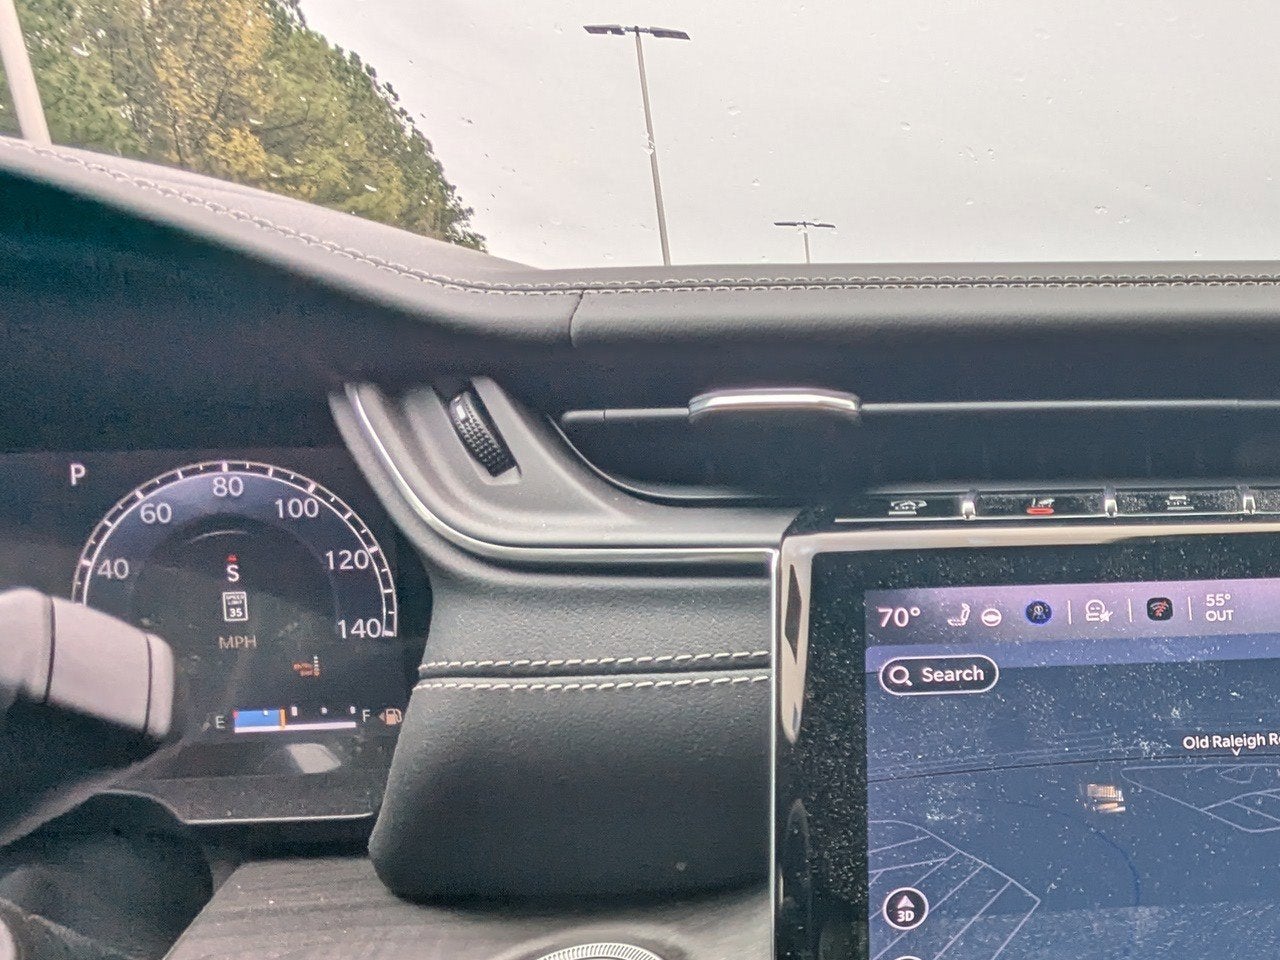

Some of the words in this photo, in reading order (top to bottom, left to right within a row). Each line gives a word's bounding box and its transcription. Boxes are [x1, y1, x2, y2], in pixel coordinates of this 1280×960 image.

[70, 463, 87, 486] P
[212, 477, 244, 497] 80
[140, 503, 172, 524] 60
[275, 498, 319, 520] 100
[97, 559, 130, 580] 40
[325, 549, 370, 571] 120
[227, 565, 240, 583] S
[1205, 593, 1231, 607] 55°
[230, 607, 243, 618] 35
[877, 606, 921, 629] 70°
[1205, 609, 1234, 623] OUT
[337, 619, 383, 639] 140
[218, 635, 258, 651] MPH
[921, 664, 986, 684] Search
[215, 715, 226, 730] E
[362, 709, 372, 723] F
[1182, 735, 1210, 749] Old
[1212, 733, 1266, 750] Raleigh
[897, 908, 916, 923] 3D
